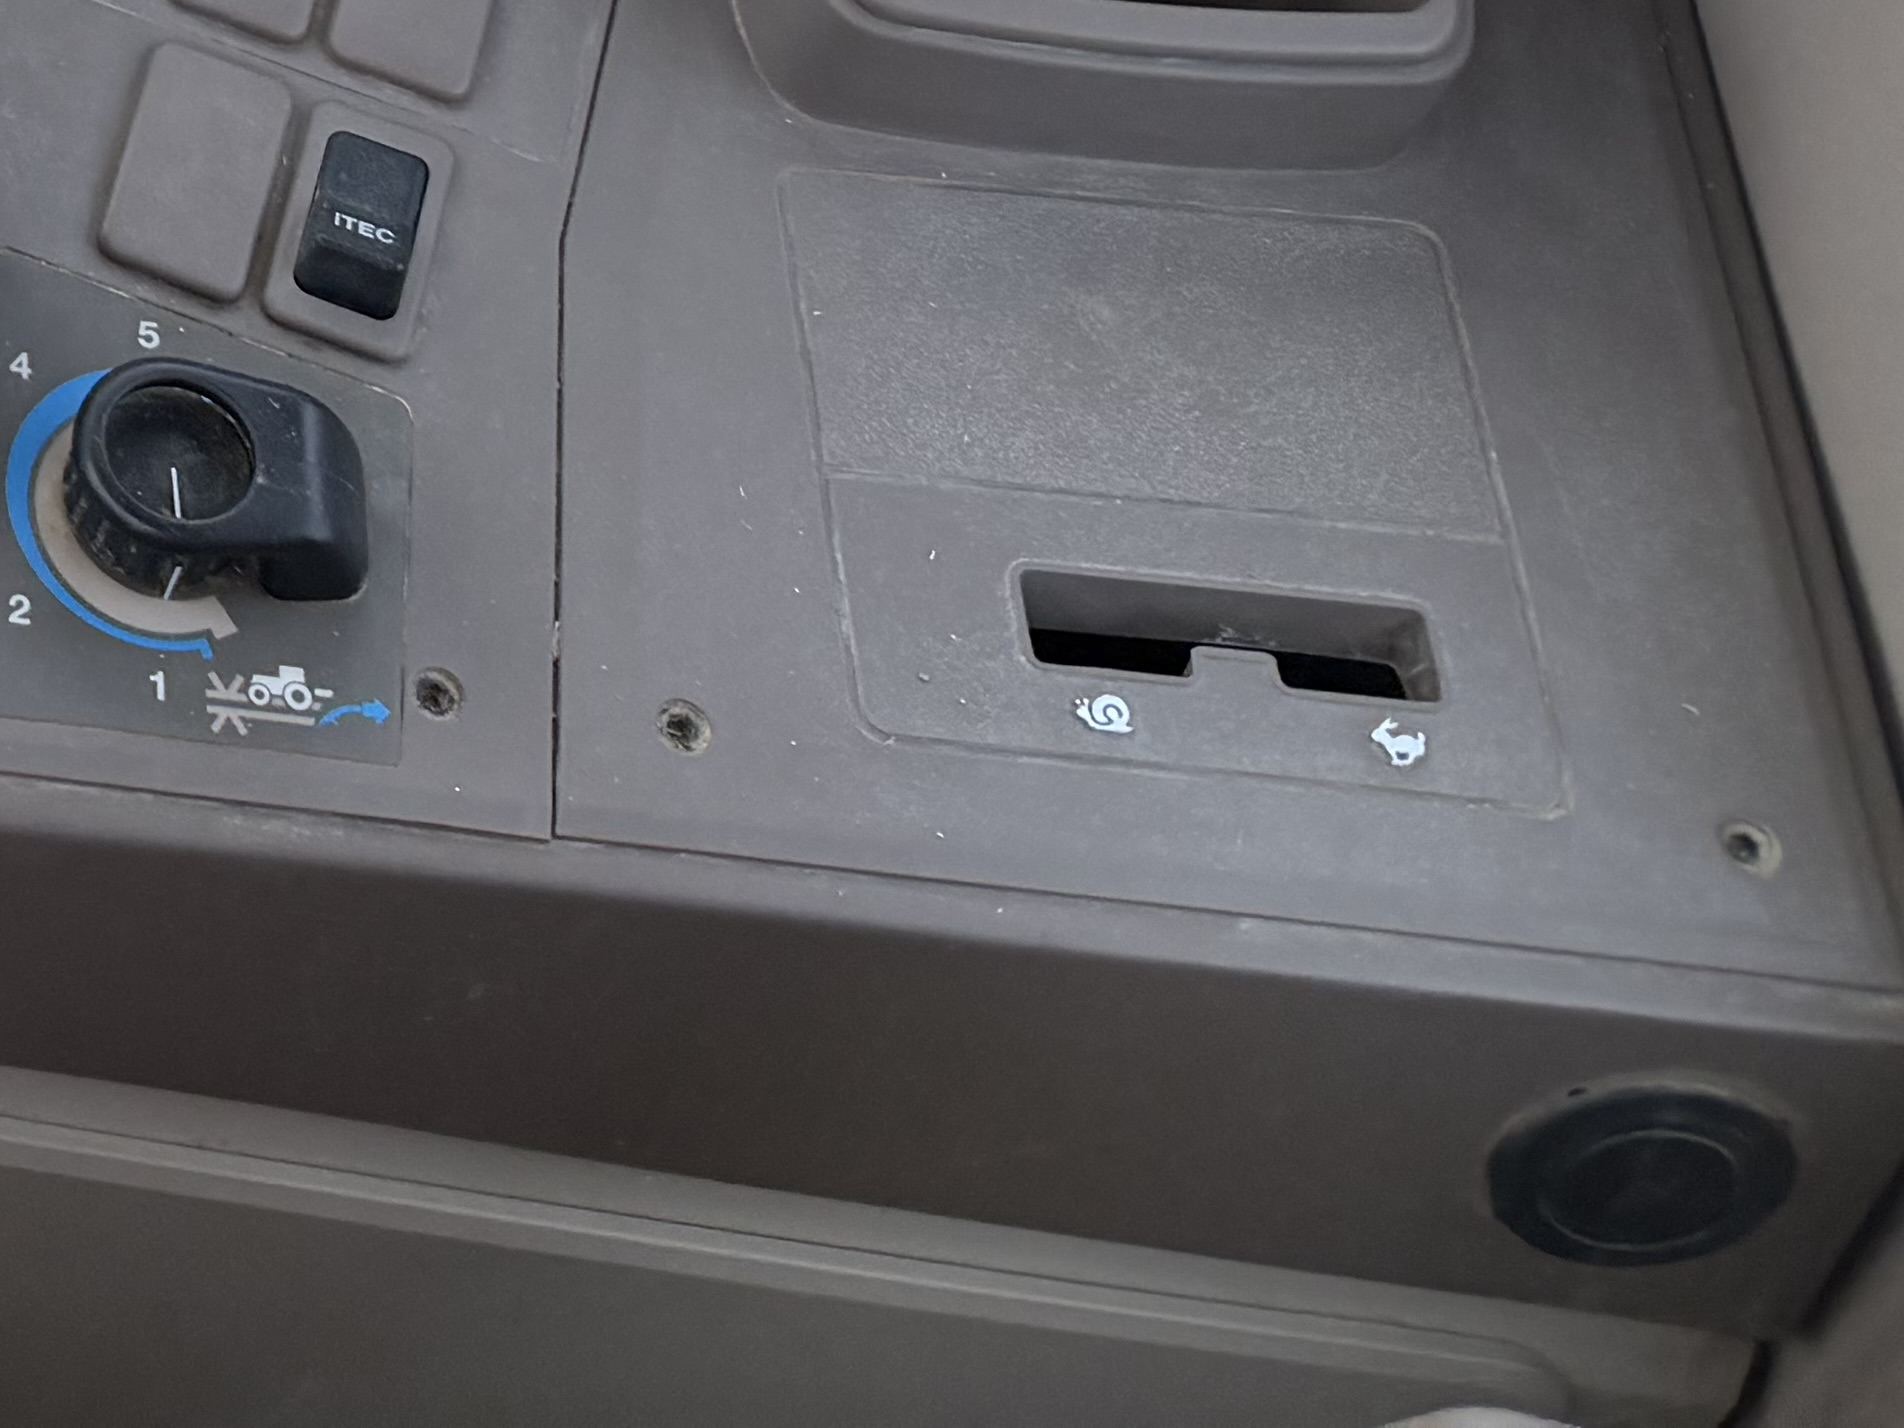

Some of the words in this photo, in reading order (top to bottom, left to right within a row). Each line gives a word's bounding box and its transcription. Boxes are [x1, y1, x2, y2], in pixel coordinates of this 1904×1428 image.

[333, 211, 396, 245] ITEC
[137, 320, 161, 349] 5
[9, 351, 33, 380] 4
[8, 594, 32, 626] 2
[149, 669, 166, 701] 1
